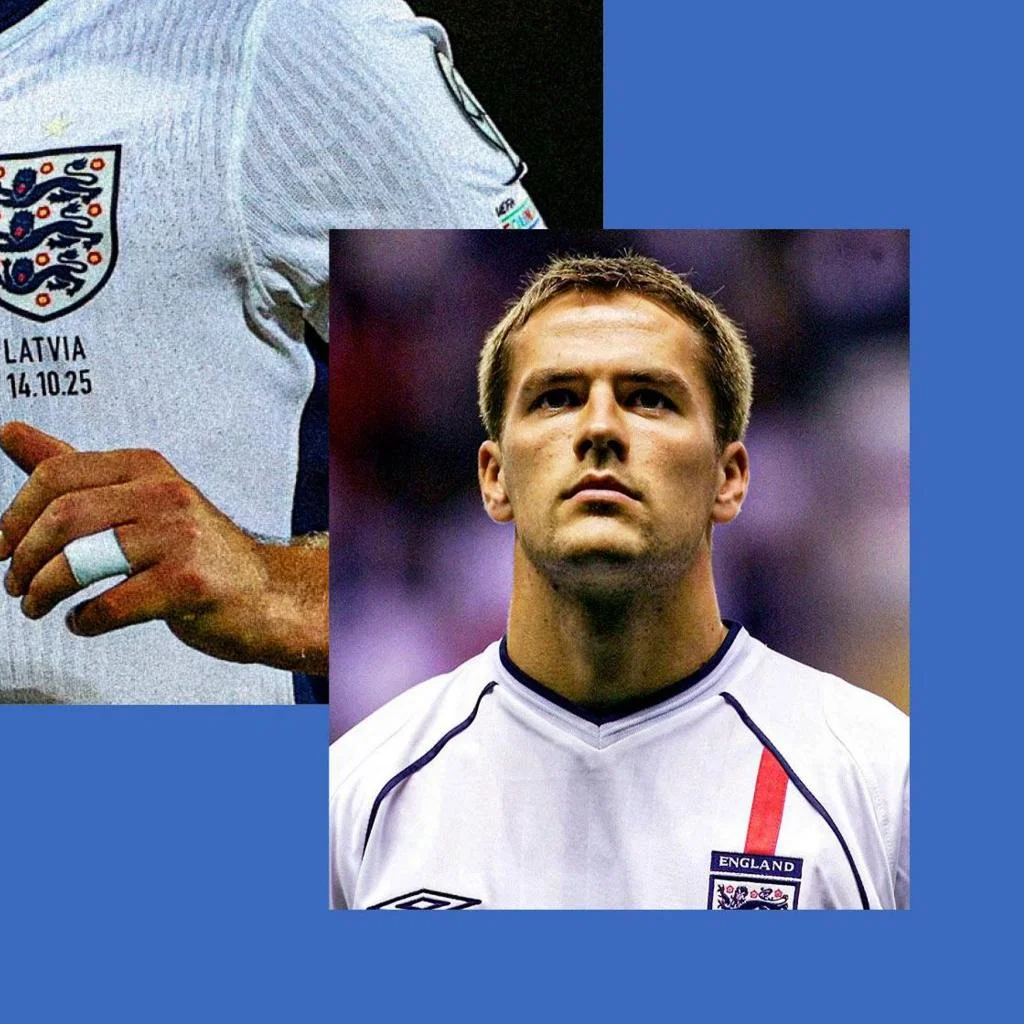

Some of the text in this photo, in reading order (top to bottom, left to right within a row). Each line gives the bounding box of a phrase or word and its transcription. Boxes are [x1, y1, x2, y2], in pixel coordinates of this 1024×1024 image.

[4, 336, 86, 364] LATVIA
[6, 370, 92, 398] 14.10.25
[719, 856, 794, 872] ENGLAND
